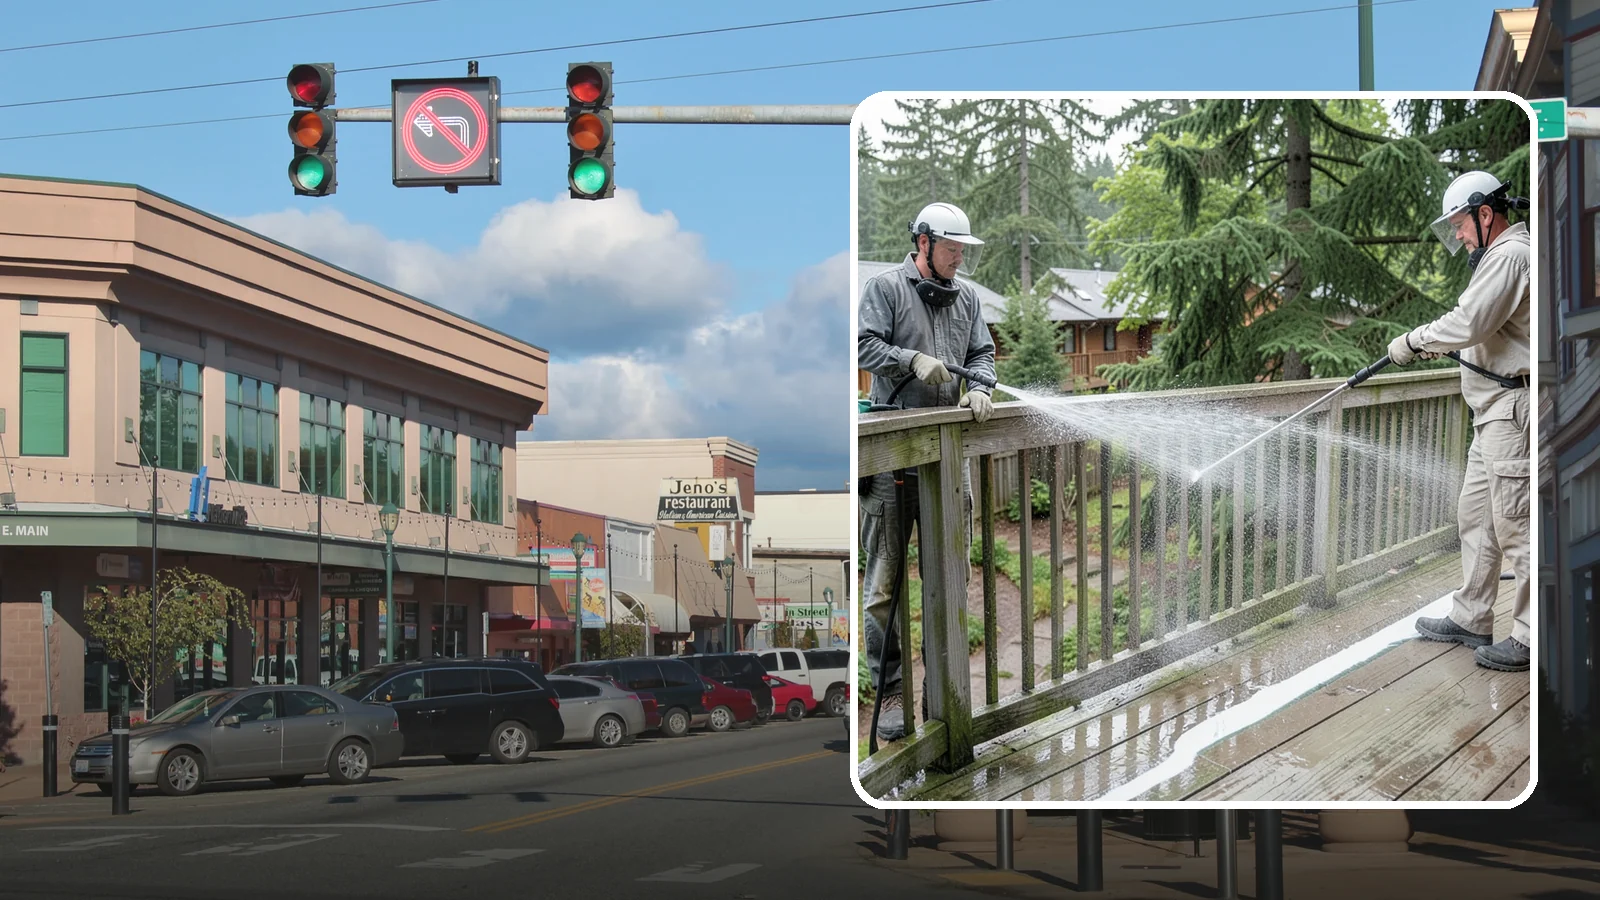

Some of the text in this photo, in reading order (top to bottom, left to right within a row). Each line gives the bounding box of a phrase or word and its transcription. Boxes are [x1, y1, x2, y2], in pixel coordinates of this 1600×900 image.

[670, 480, 727, 494] Jeno's
[665, 497, 731, 508] restaurant
[659, 510, 681, 519] Italian
[686, 510, 714, 518] American
[715, 510, 737, 518] Cuisine
[2, 526, 48, 536] E. MAIN
[798, 608, 828, 616] Street
